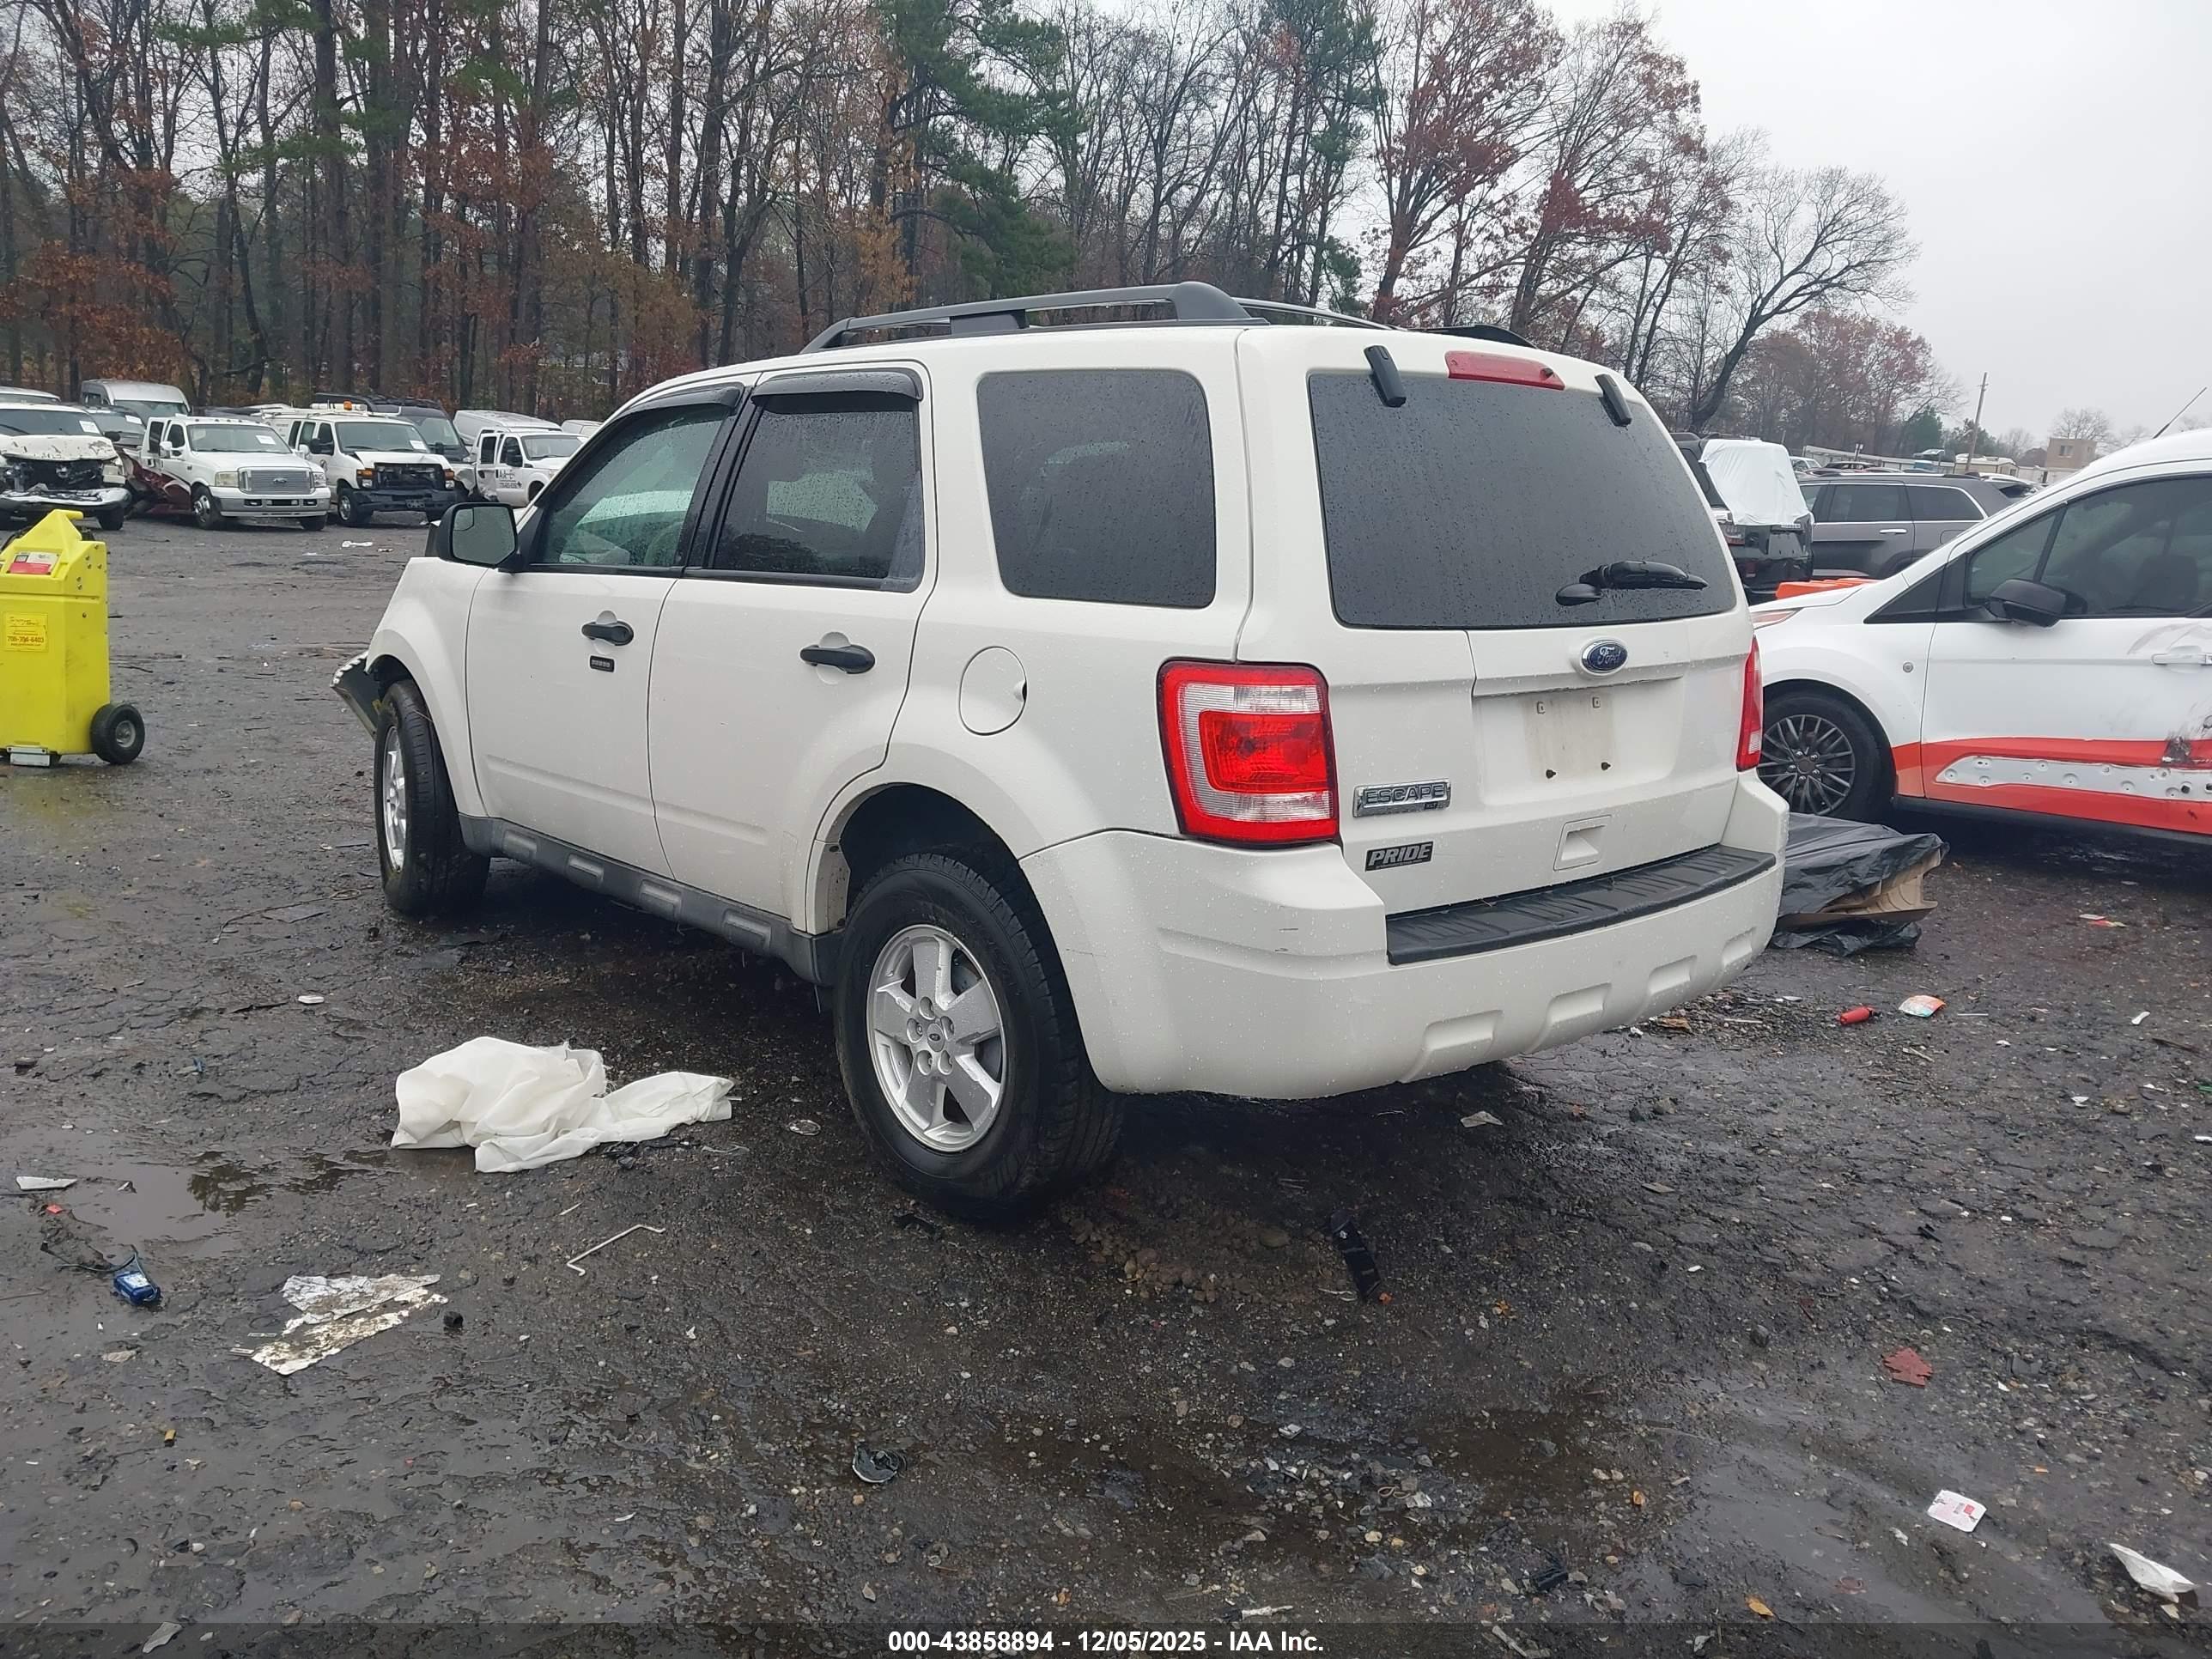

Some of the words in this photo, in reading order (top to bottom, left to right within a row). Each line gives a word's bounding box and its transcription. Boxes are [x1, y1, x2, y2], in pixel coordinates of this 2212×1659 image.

[1597, 645, 1621, 665] Ford
[1364, 783, 1445, 805] ESCAPE
[1368, 843, 1432, 866] PRIDE
